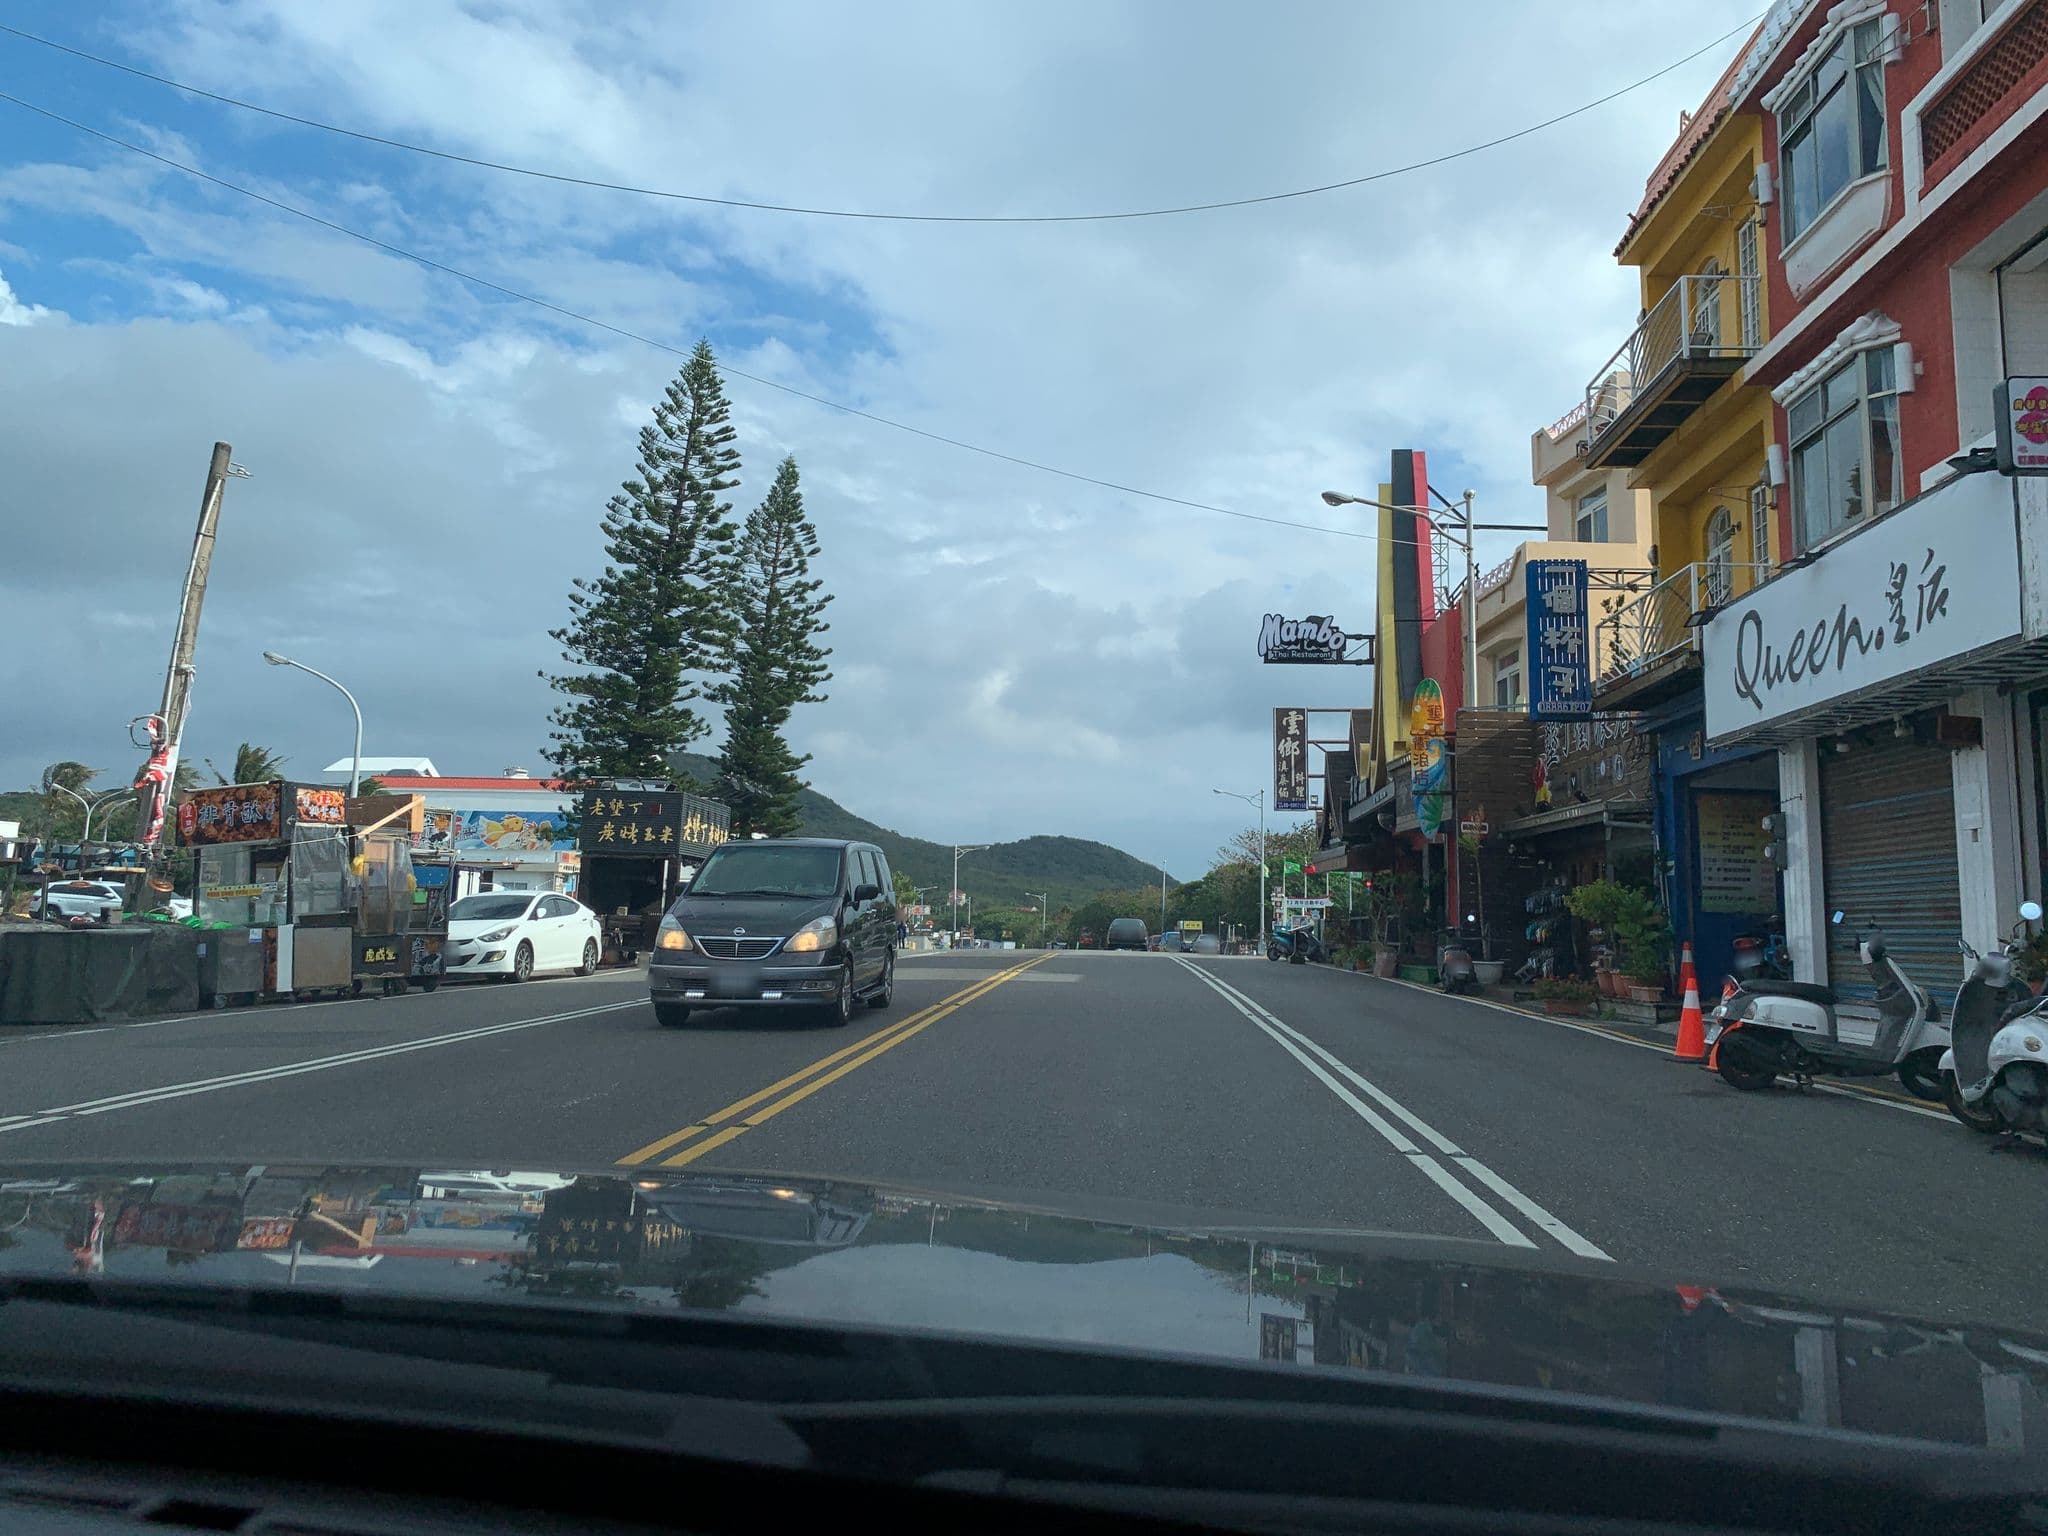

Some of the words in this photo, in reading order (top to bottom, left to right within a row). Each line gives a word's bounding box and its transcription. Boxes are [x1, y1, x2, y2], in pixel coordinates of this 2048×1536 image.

[1258, 613, 1346, 657] Mambo
[1541, 566, 1582, 693] 一個杯子
[1273, 650, 1290, 658] Thai
[1291, 650, 1331, 658] Restaurant
[589, 797, 643, 816] 老墾丁
[598, 821, 674, 844] 炭烤玉米
